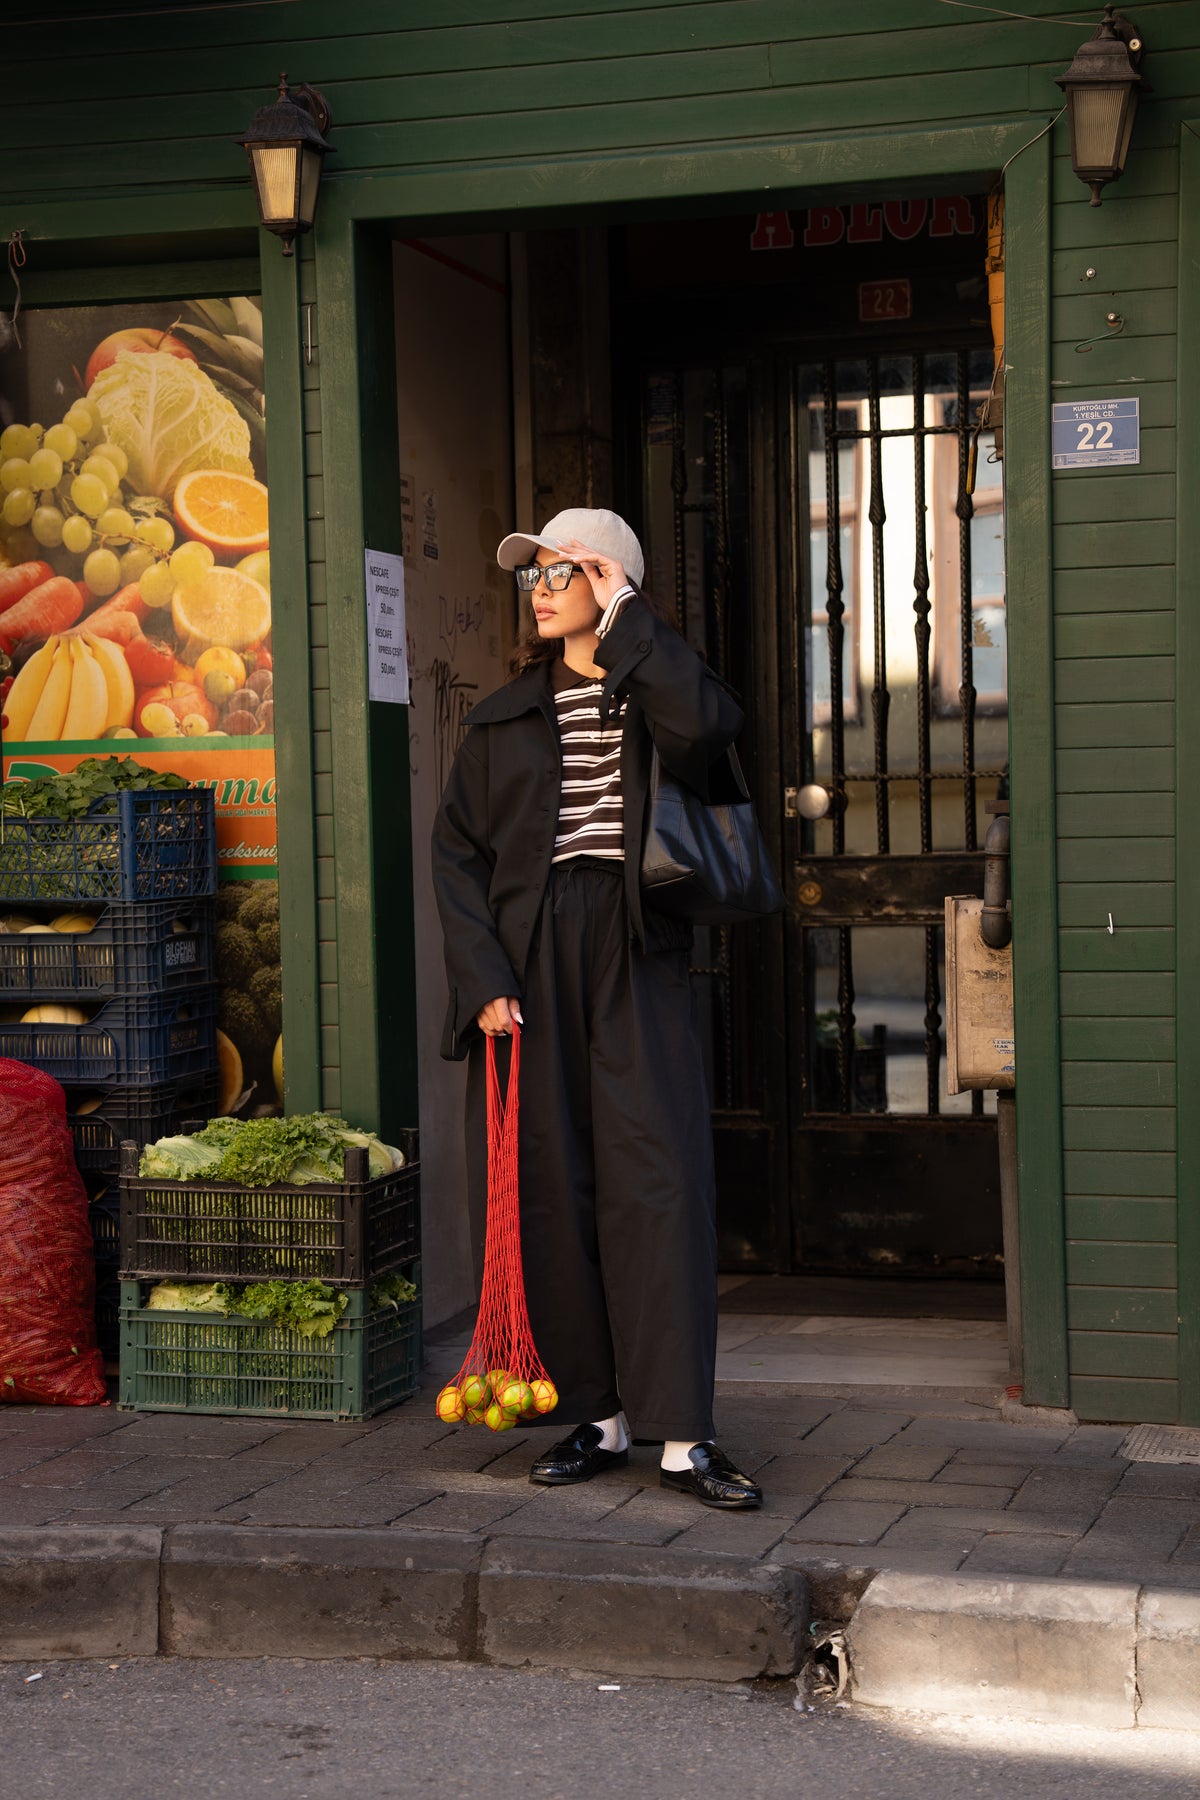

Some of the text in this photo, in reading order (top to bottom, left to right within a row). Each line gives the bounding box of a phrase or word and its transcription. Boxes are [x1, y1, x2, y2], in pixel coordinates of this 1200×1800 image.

[873, 287, 896, 313] 22
[1073, 403, 1107, 412] KURTOĞLU
[1077, 421, 1113, 450] 22
